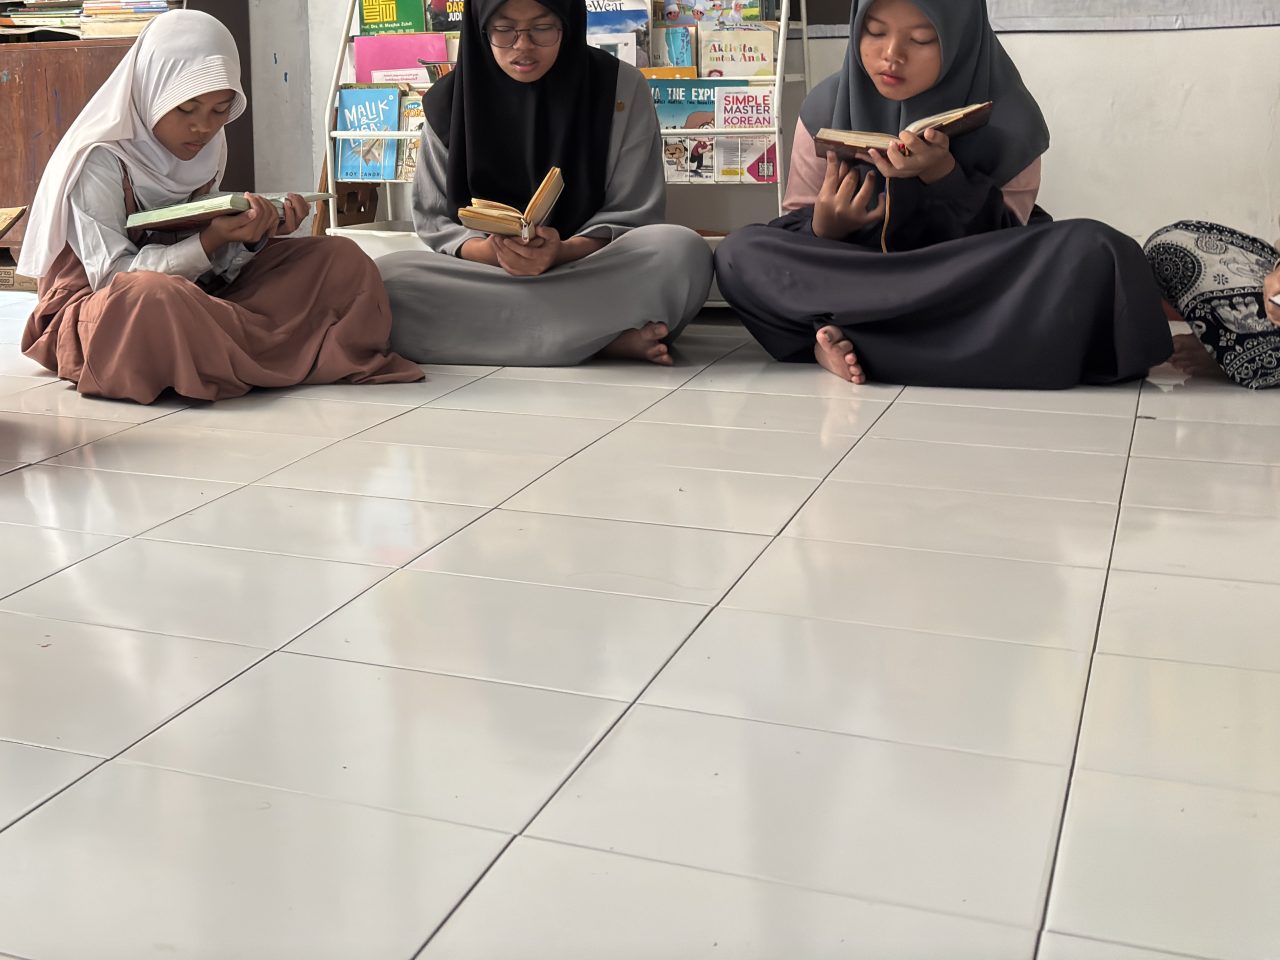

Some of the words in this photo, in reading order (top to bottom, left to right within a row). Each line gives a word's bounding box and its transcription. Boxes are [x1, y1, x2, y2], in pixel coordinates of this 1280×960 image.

[709, 43, 760, 53] Aktivitas
[709, 53, 736, 62] untuk
[740, 52, 767, 63] Anak
[666, 87, 686, 100] THE
[723, 95, 770, 106] SIMPLE
[344, 100, 390, 129] MALIK
[723, 105, 771, 115] MASTER
[723, 116, 771, 125] KOREAN
